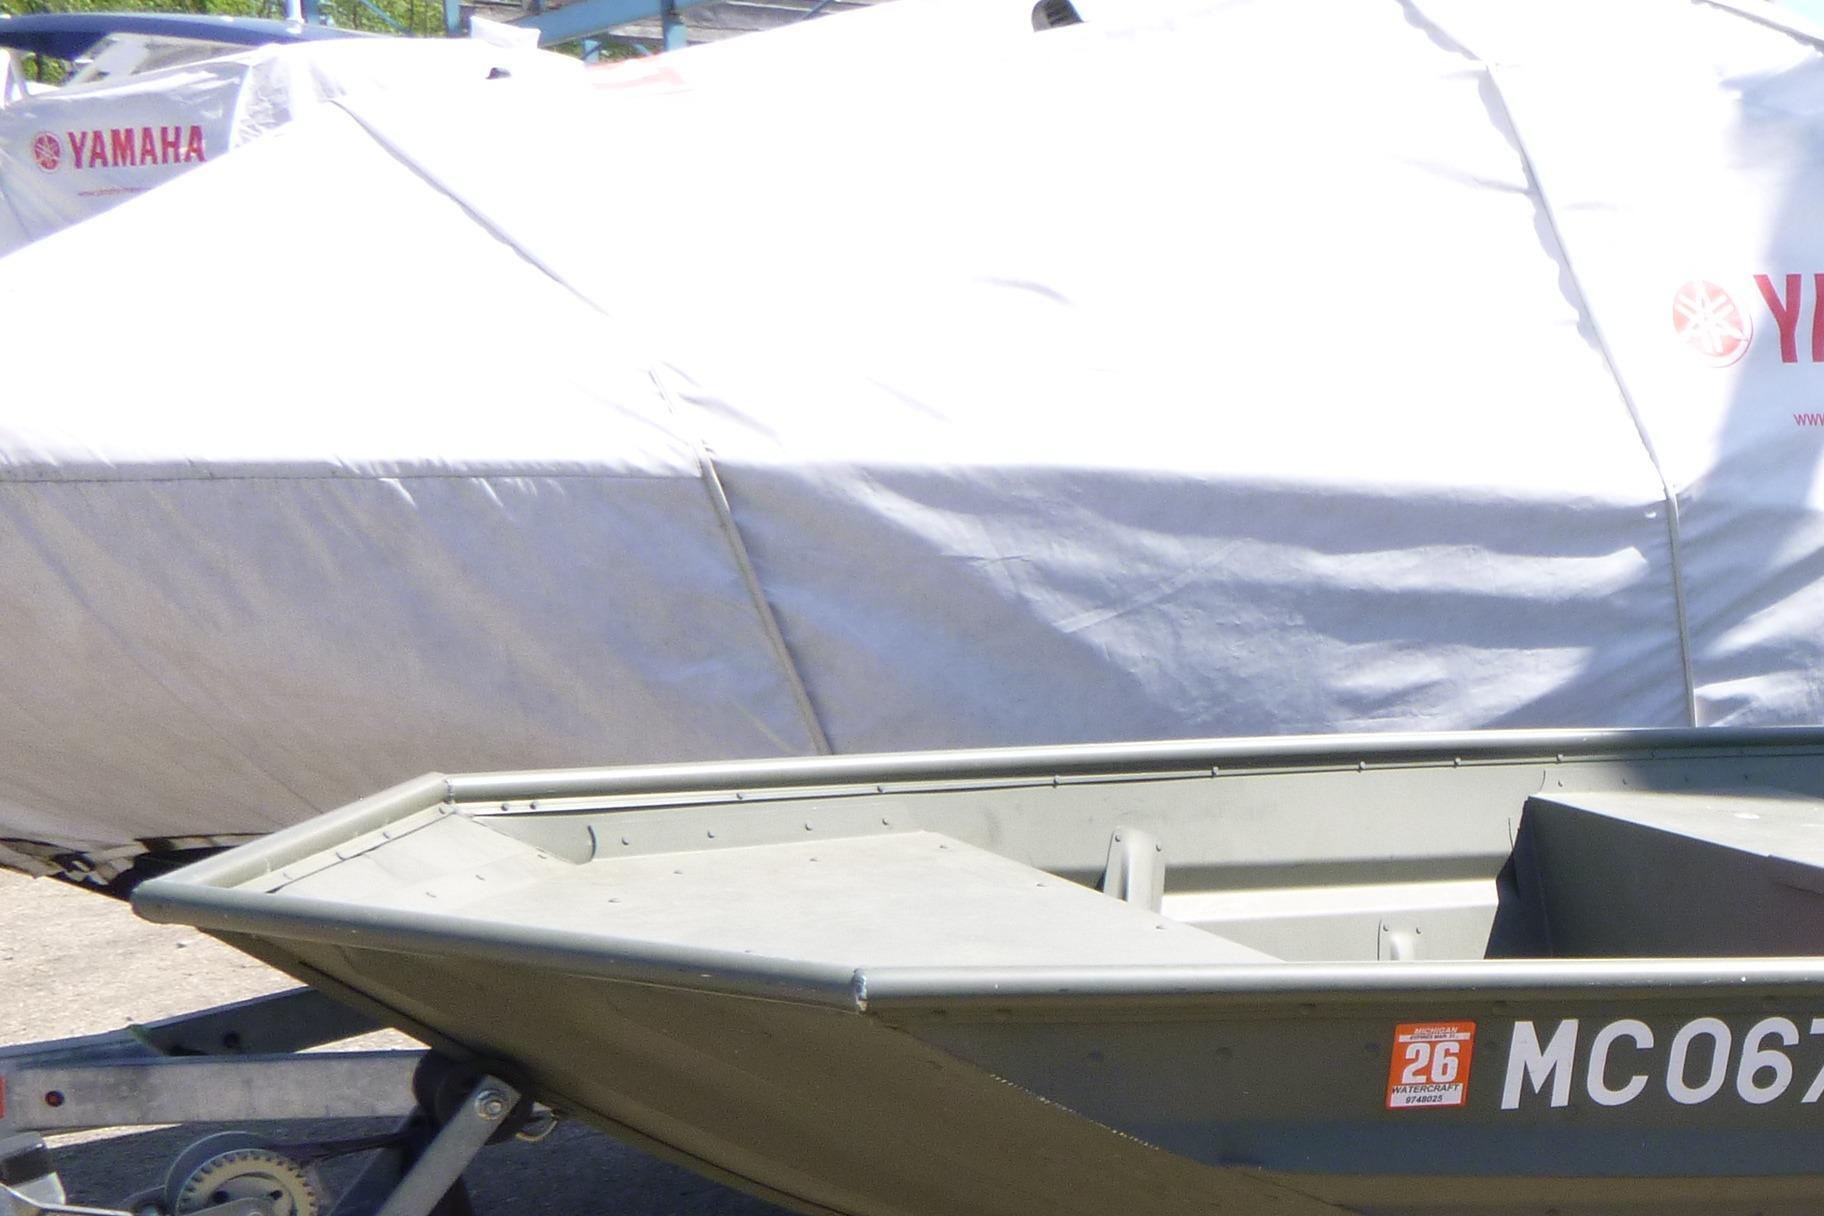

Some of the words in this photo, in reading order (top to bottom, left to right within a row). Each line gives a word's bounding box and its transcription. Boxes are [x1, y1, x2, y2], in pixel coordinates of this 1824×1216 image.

[67, 125, 207, 169] YAMAHA
[1413, 1026, 1459, 1035] MICHIGAN
[1401, 1041, 1461, 1084] 26
[1392, 1084, 1461, 1094] WATERCRAFT
